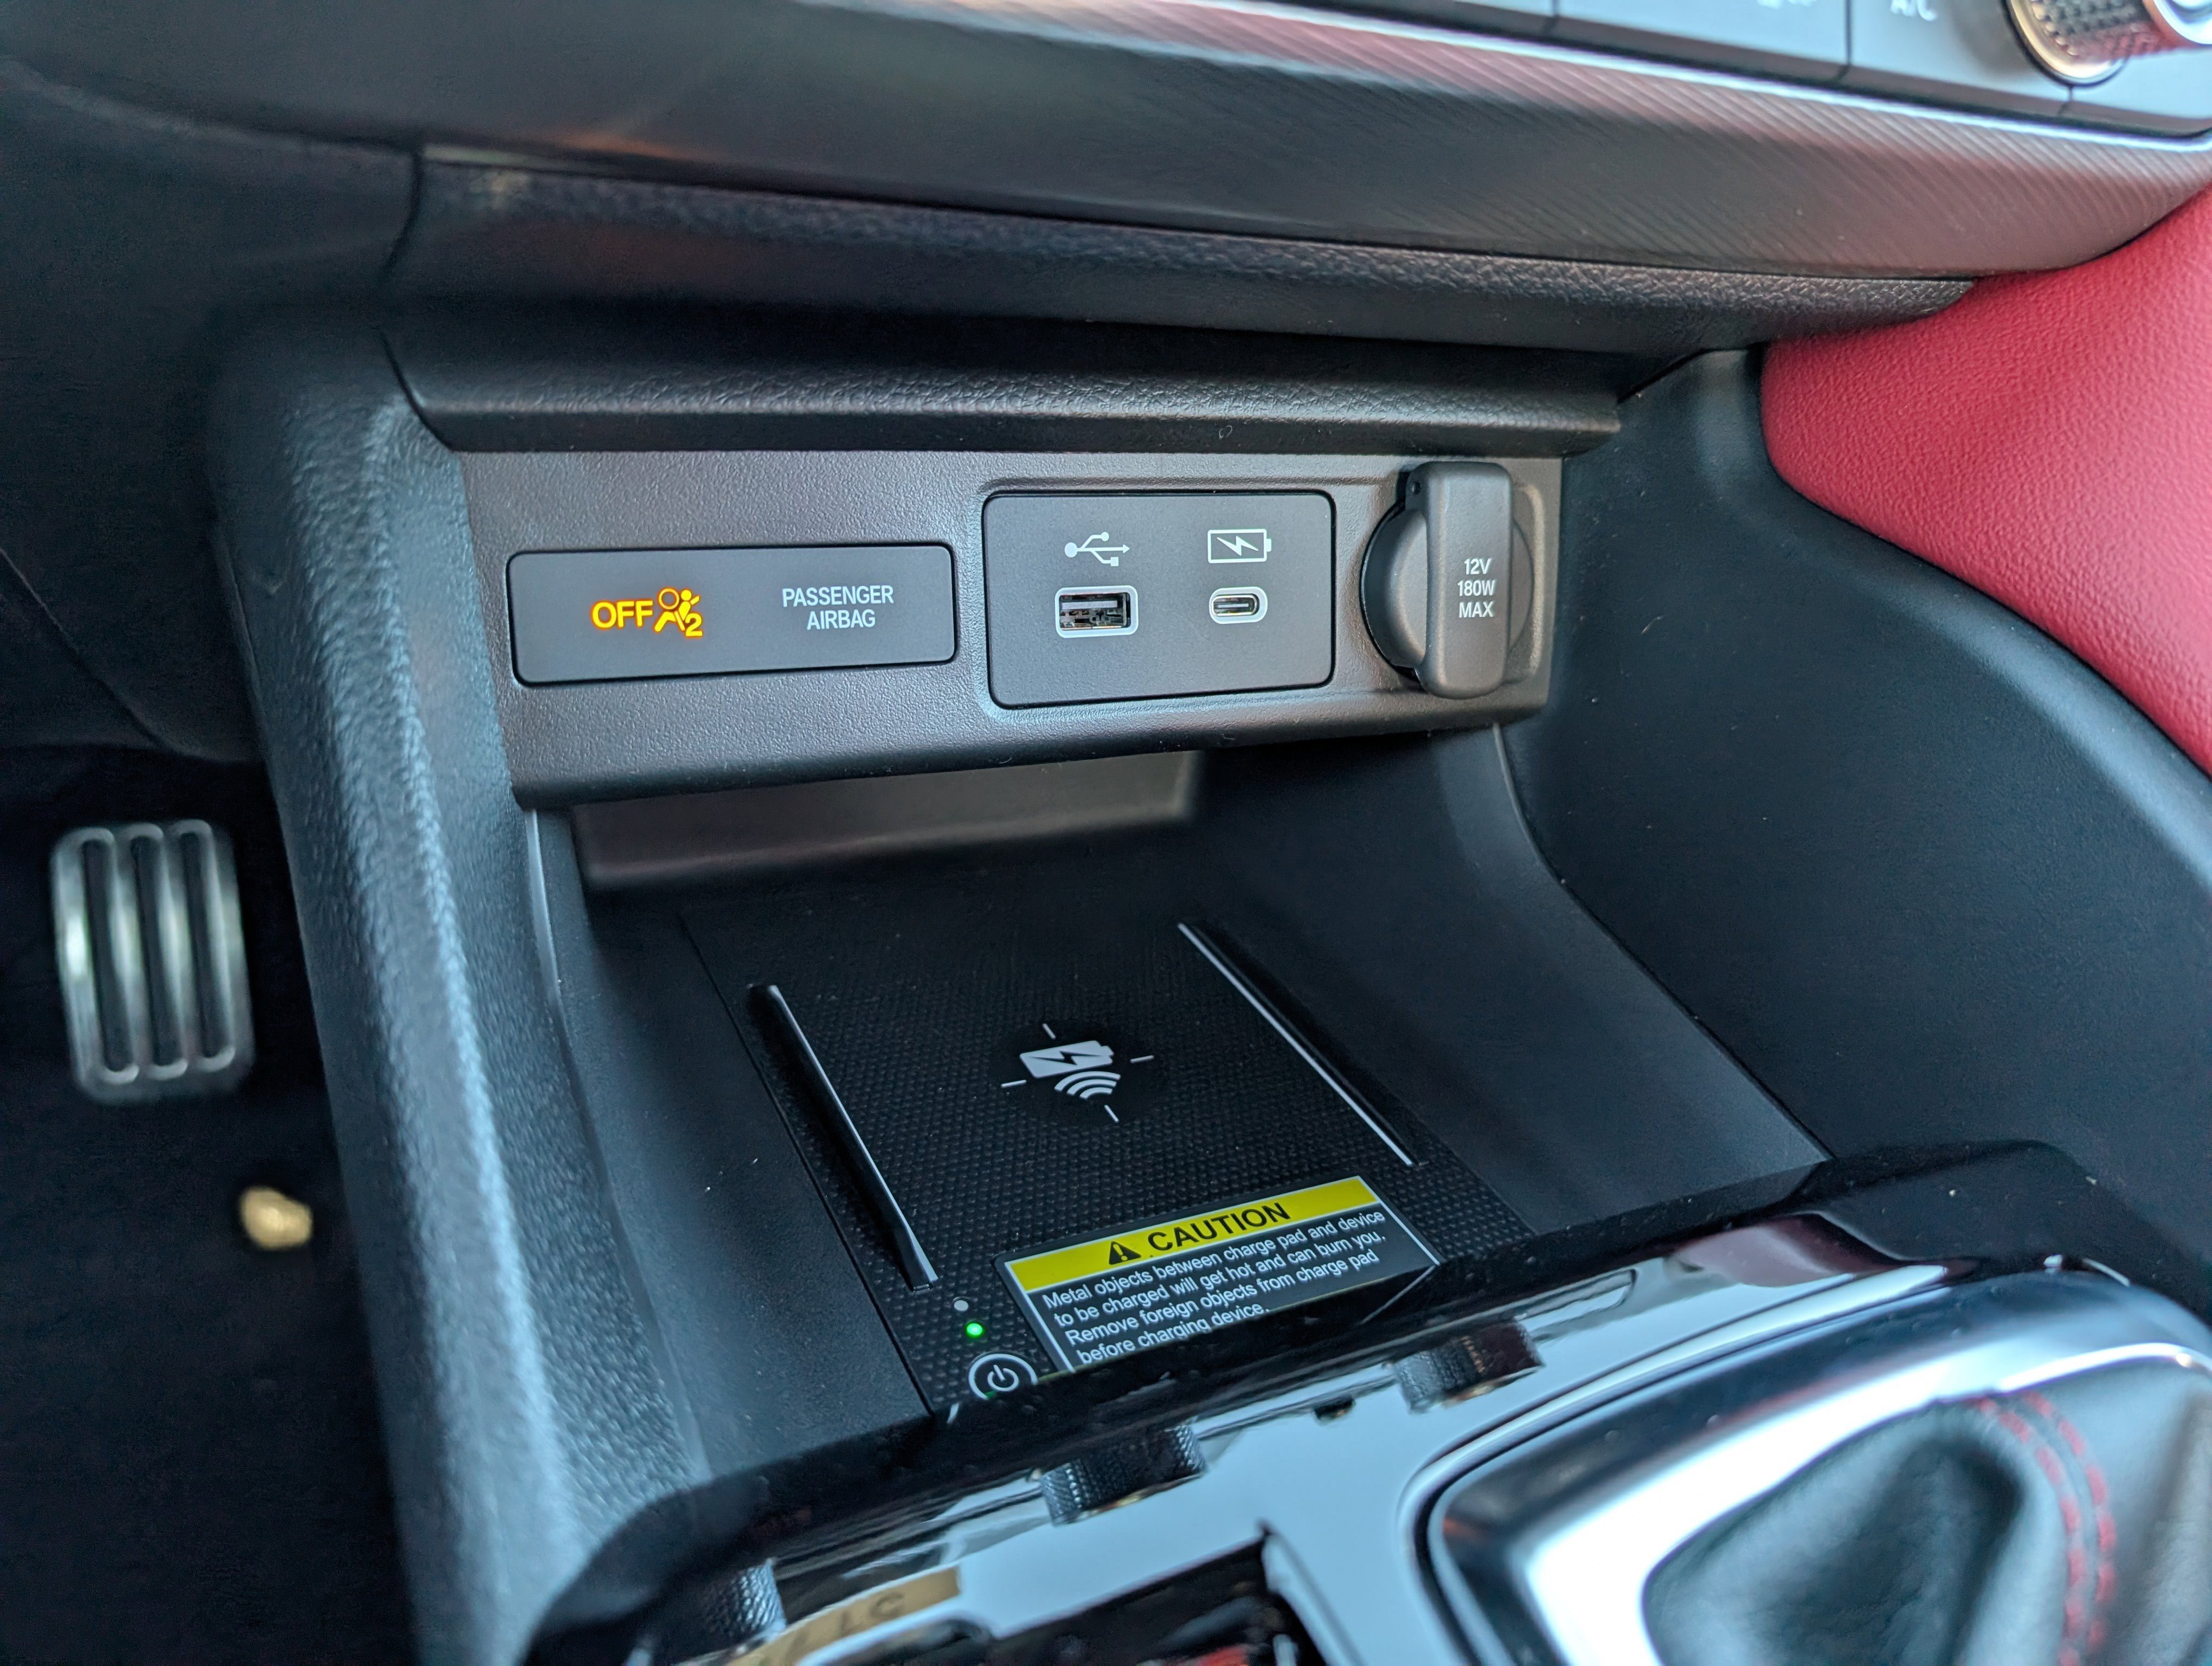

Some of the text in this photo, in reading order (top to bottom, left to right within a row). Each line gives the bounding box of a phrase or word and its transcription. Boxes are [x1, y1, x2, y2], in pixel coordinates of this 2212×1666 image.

[1464, 558, 1492, 575] 12V
[782, 585, 894, 607] PASSENGER
[1457, 579, 1496, 597] 180W
[592, 600, 653, 629] OFF
[806, 608, 876, 630] AIRBAG
[1459, 601, 1494, 618] MAX
[1147, 1202, 1291, 1251] CAUTION
[1042, 1211, 1386, 1309] Metal objects between charge pad and device
[1053, 1231, 1387, 1328] to be charged will get hot and can burn you.
[1064, 1248, 1380, 1347] Remove foreign objects from charge pad
[1076, 1303, 1270, 1364] before charging device.
